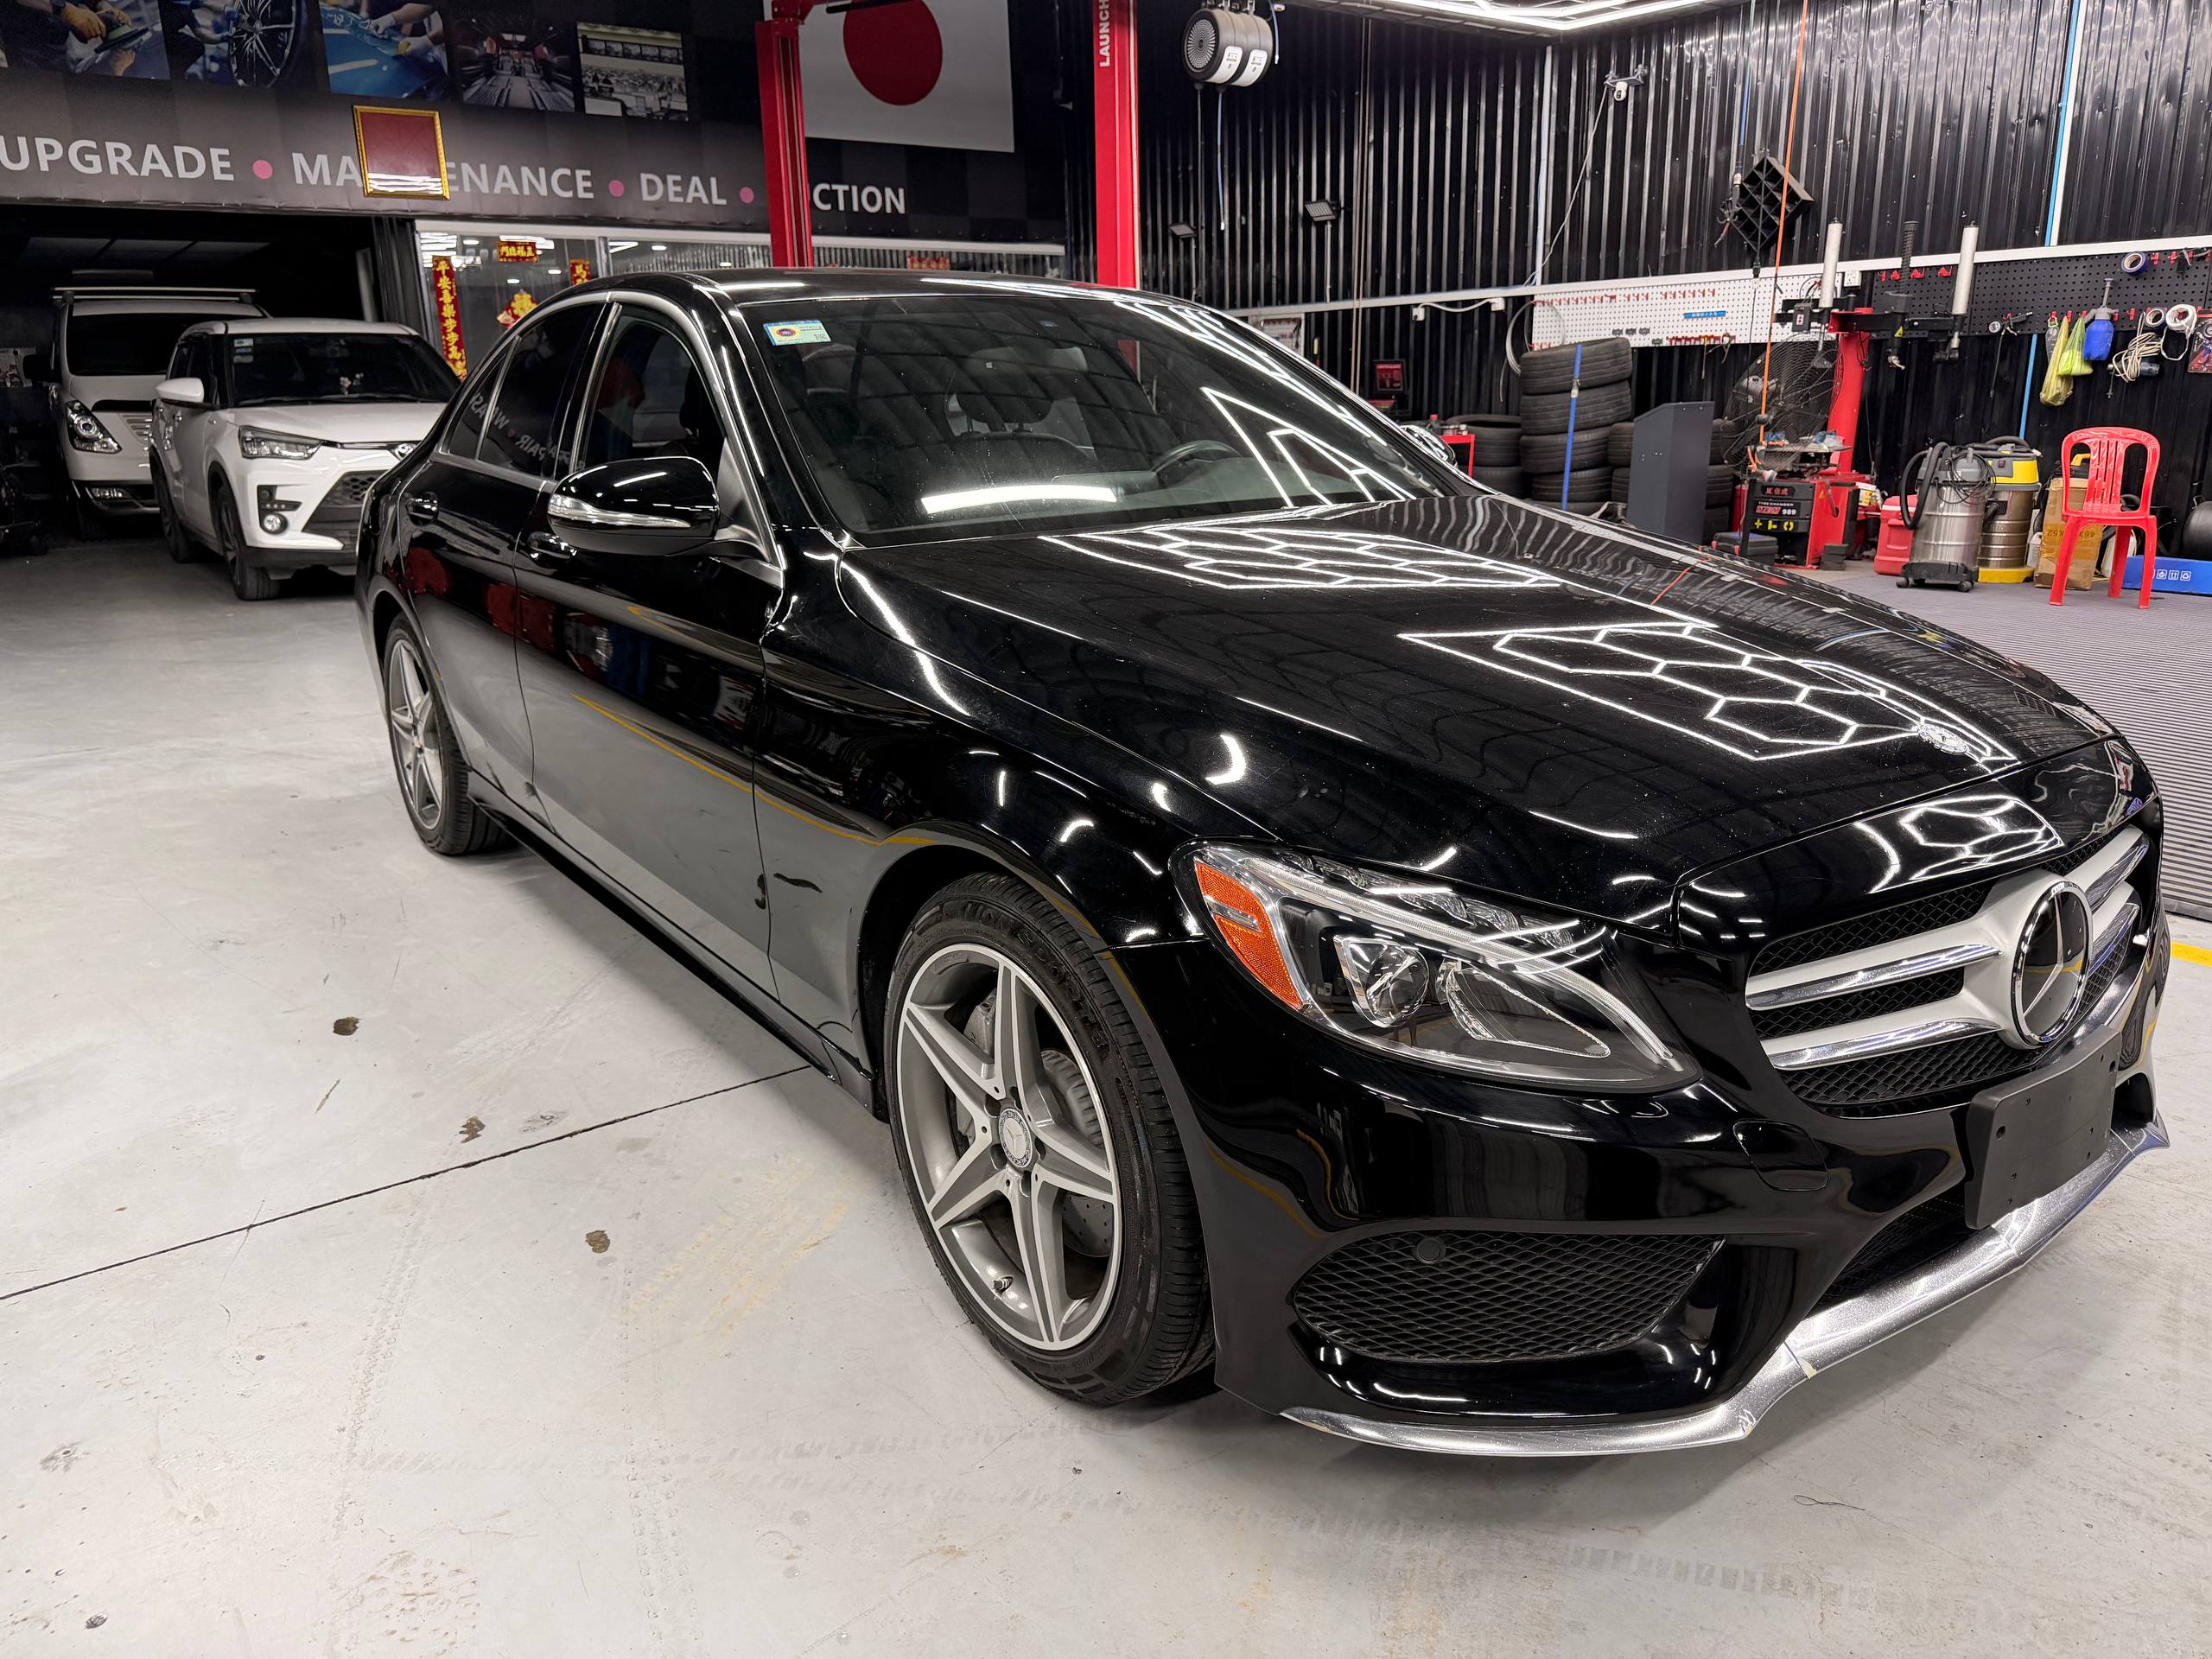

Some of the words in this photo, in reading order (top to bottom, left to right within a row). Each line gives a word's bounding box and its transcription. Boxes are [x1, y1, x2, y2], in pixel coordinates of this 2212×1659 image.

[1098, 0, 1110, 67] LAUNCH
[0, 135, 235, 181] UPGRADE
[292, 152, 594, 200] MAENANCE
[639, 173, 728, 206] DEAL
[809, 182, 906, 215] CTION
